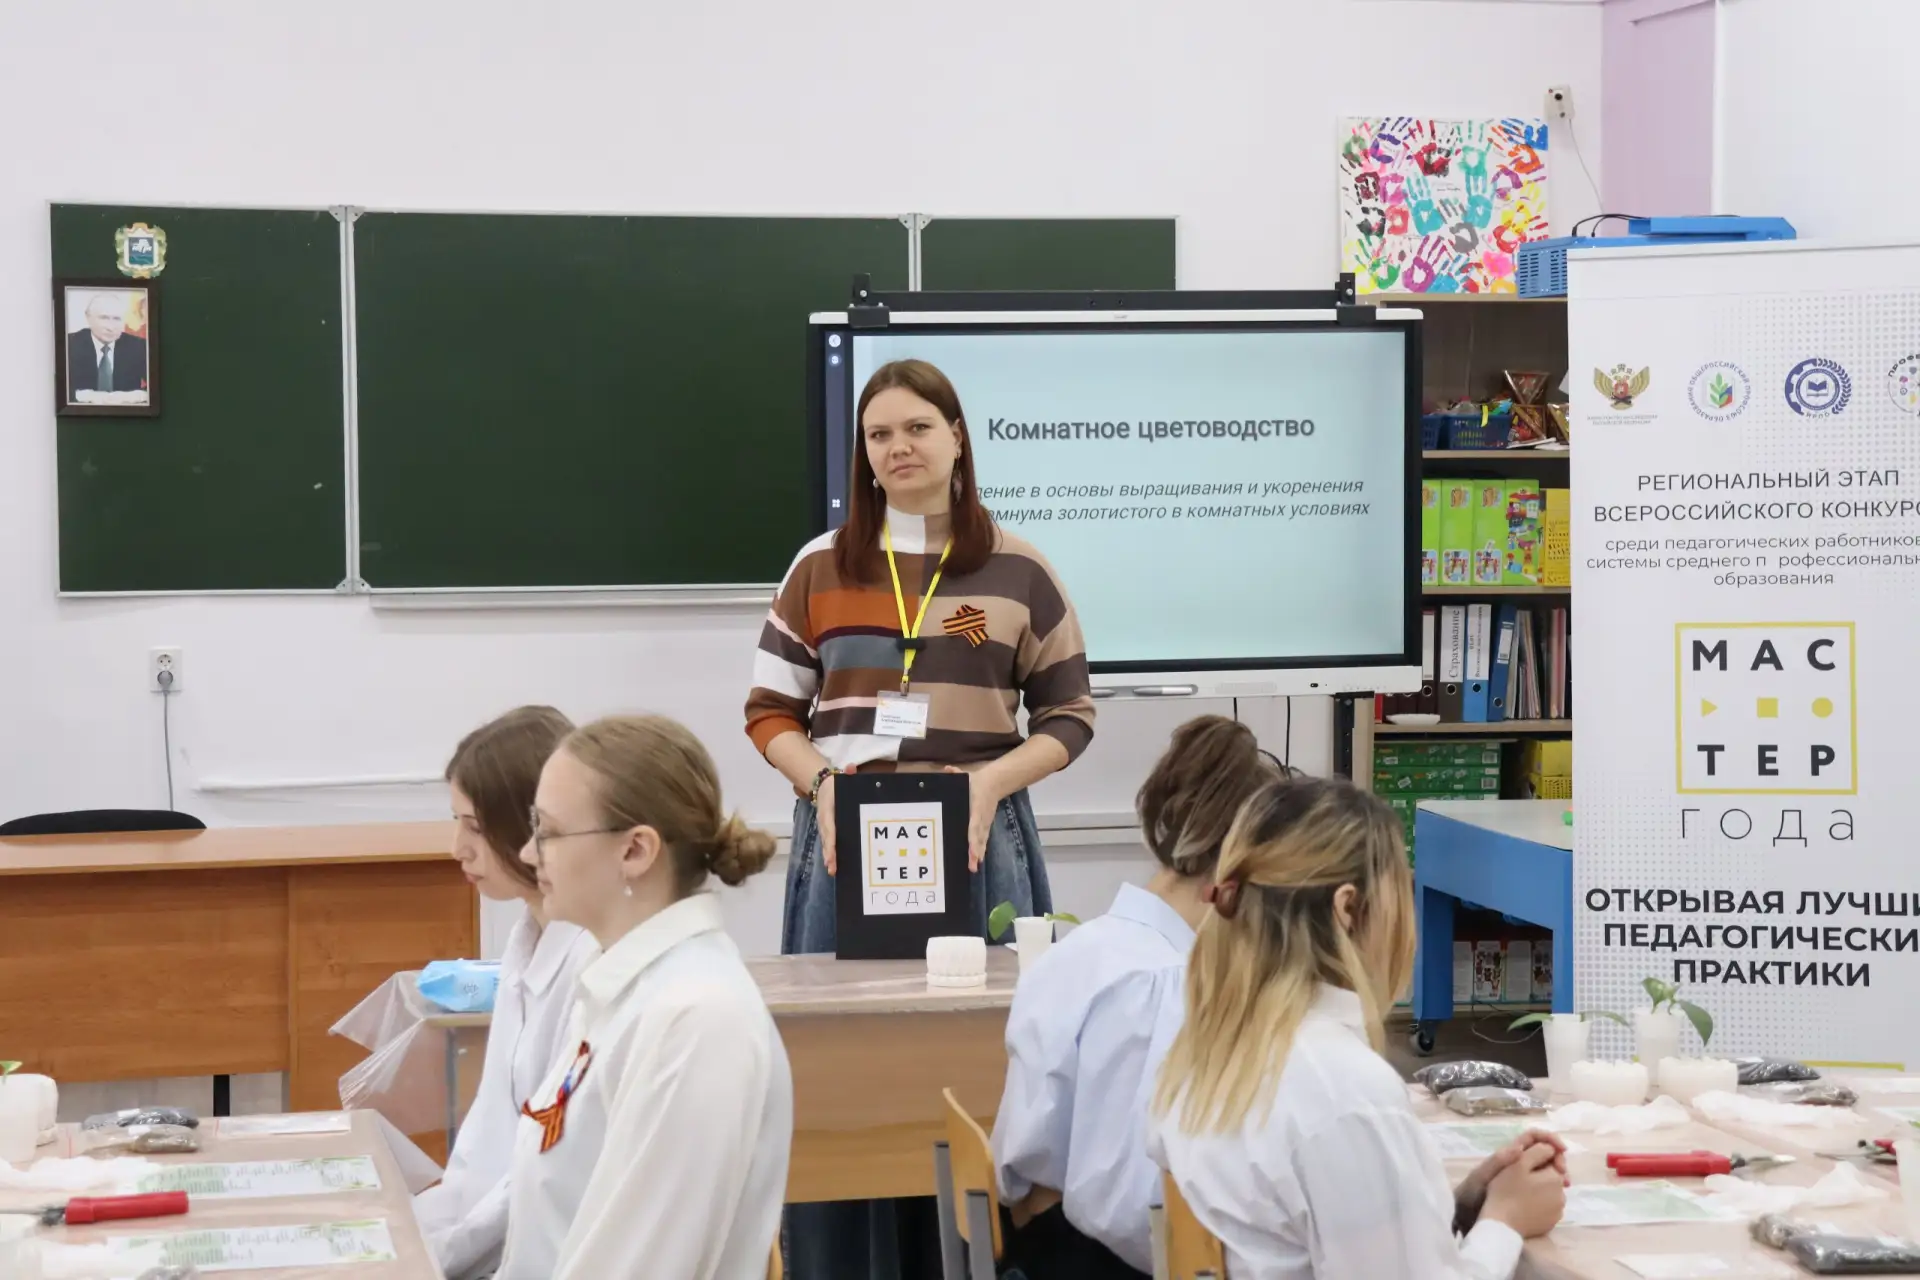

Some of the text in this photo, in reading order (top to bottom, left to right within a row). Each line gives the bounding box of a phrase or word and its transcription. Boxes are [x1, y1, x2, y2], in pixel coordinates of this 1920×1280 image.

[988, 416, 1315, 442] Комнатное цветоводство
[1030, 486, 1041, 498] в
[1046, 484, 1113, 498] основы
[1119, 483, 1243, 499] выращивания
[1247, 482, 1258, 495] и
[1262, 480, 1363, 498] укоренения
[1638, 470, 1898, 490] РЕГИОНАЛЬНЫЙ ЭТАП
[1057, 506, 1167, 521] золотистого
[1171, 506, 1181, 518] в
[1187, 504, 1286, 518] комнатных
[1290, 503, 1370, 520] условиях
[1594, 501, 1813, 522] ВСЕРОССИЙСКОГО
[1605, 533, 1920, 552] среди педагогических работников
[1587, 557, 1661, 569] системы
[1666, 556, 1750, 571] среднего
[1714, 573, 1834, 586] образования
[1448, 609, 1460, 678] Страхование
[1692, 639, 1836, 671] МАС
[1697, 744, 1836, 776] ТЕР
[874, 826, 928, 839] МАС
[1682, 808, 1854, 848] года
[877, 866, 928, 880] ТЕР
[871, 890, 936, 907] года
[1585, 888, 1785, 914] ОТКРЫВАЯ
[1603, 923, 1919, 953] ПЕДАГОГИЧЕСКИ
[1674, 959, 1871, 987] ПРАКТИКИ
